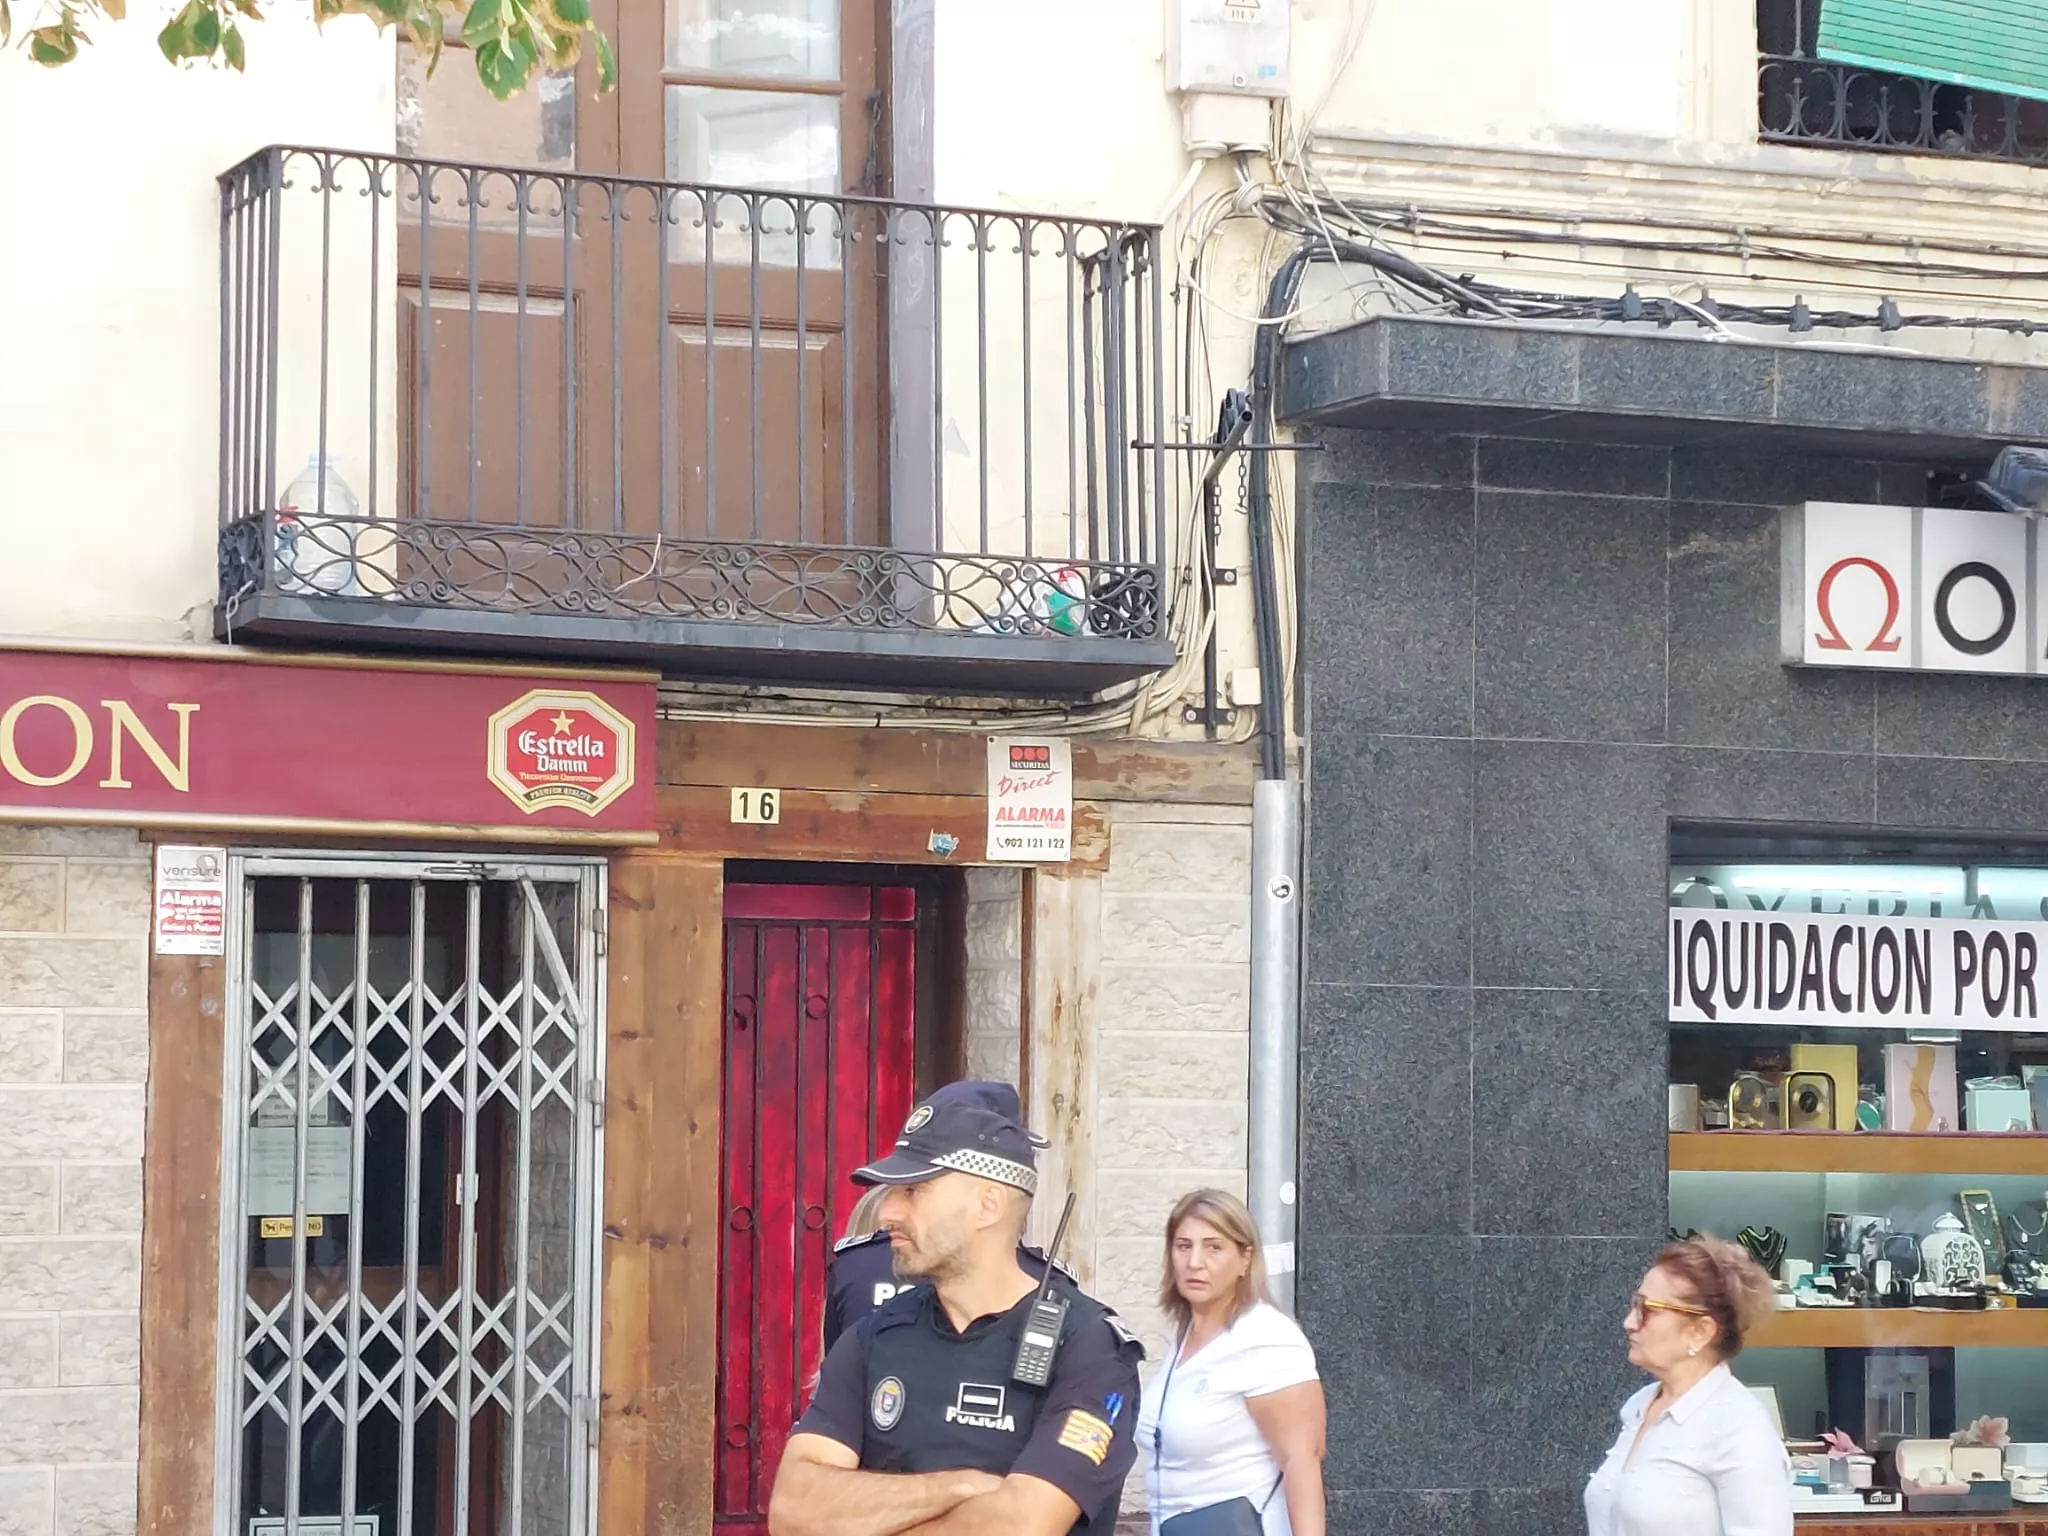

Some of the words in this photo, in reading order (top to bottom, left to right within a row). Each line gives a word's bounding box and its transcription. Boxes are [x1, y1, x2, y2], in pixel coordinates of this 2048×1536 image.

[1934, 560, 2048, 658] O
[0, 694, 200, 792] ON
[518, 730, 605, 757] Estrella
[537, 755, 588, 772] Damm
[996, 771, 1062, 797] Direct
[738, 791, 775, 820] 16
[995, 806, 1065, 822] ALARMA
[1004, 838, 1023, 849] 902
[1027, 838, 1043, 849] 121
[1048, 838, 1065, 849] 122
[161, 891, 222, 906] Alarma
[1673, 918, 1932, 1020] IQUIDACION
[1953, 930, 2038, 1019] POR
